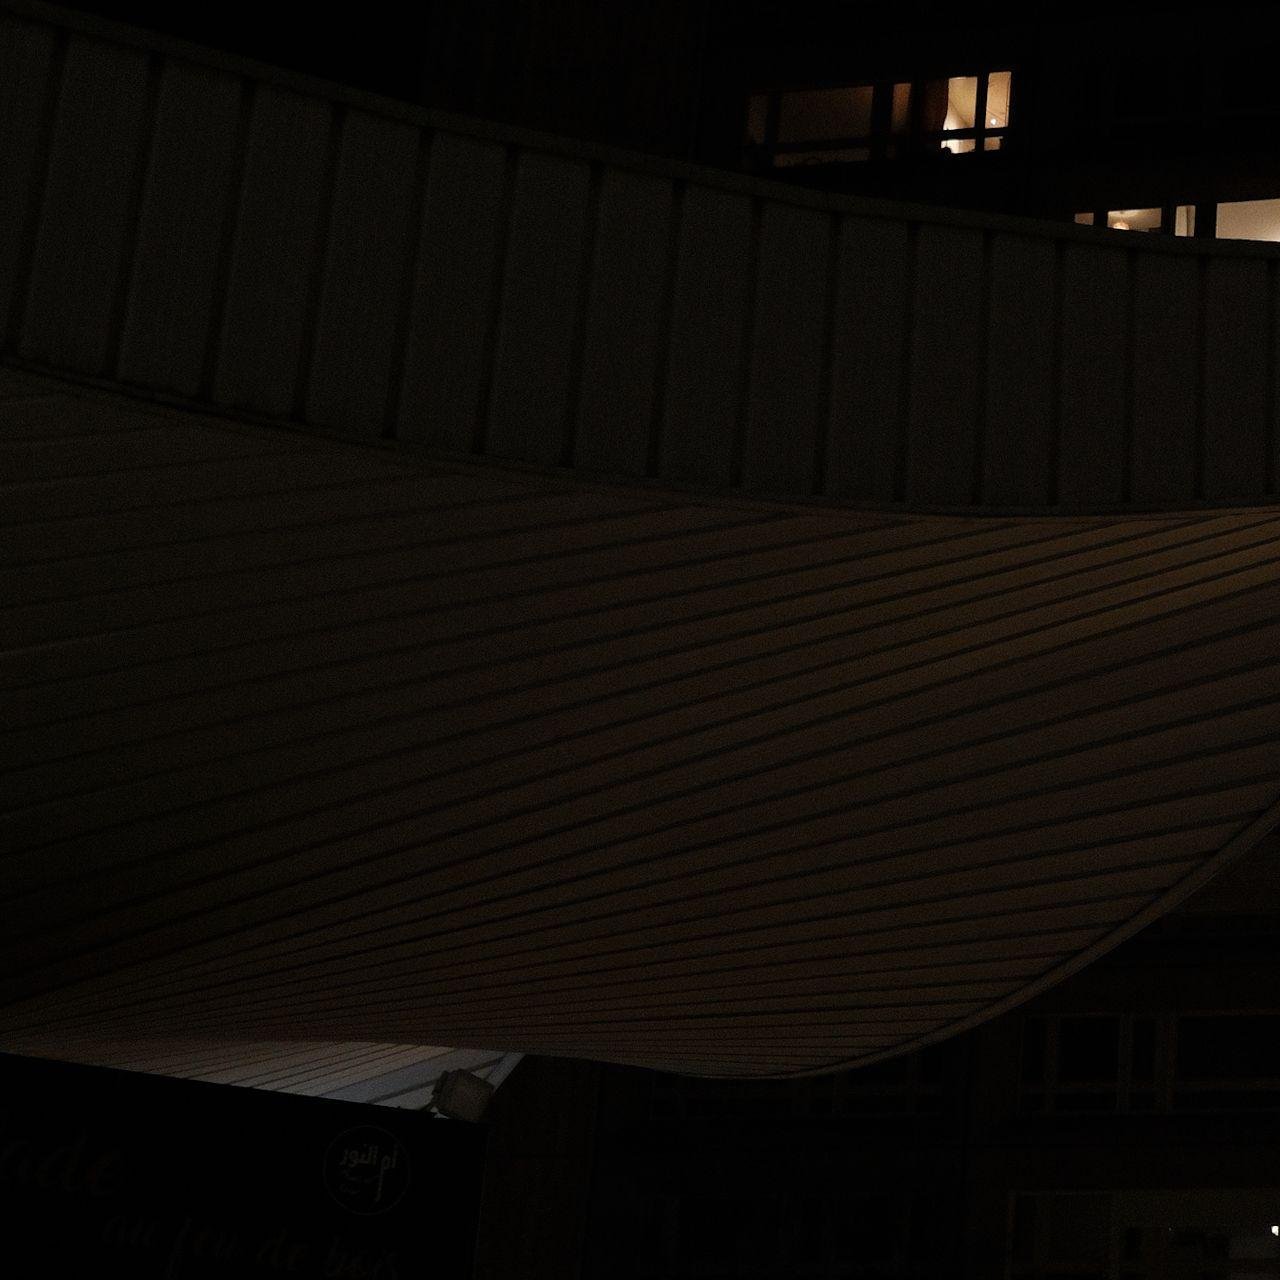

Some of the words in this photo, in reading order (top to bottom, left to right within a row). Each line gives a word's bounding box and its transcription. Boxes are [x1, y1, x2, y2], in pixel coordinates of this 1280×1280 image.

[0, 1108, 115, 1195] ade
[101, 1215, 160, 1249] au
[256, 1226, 309, 1272] de
